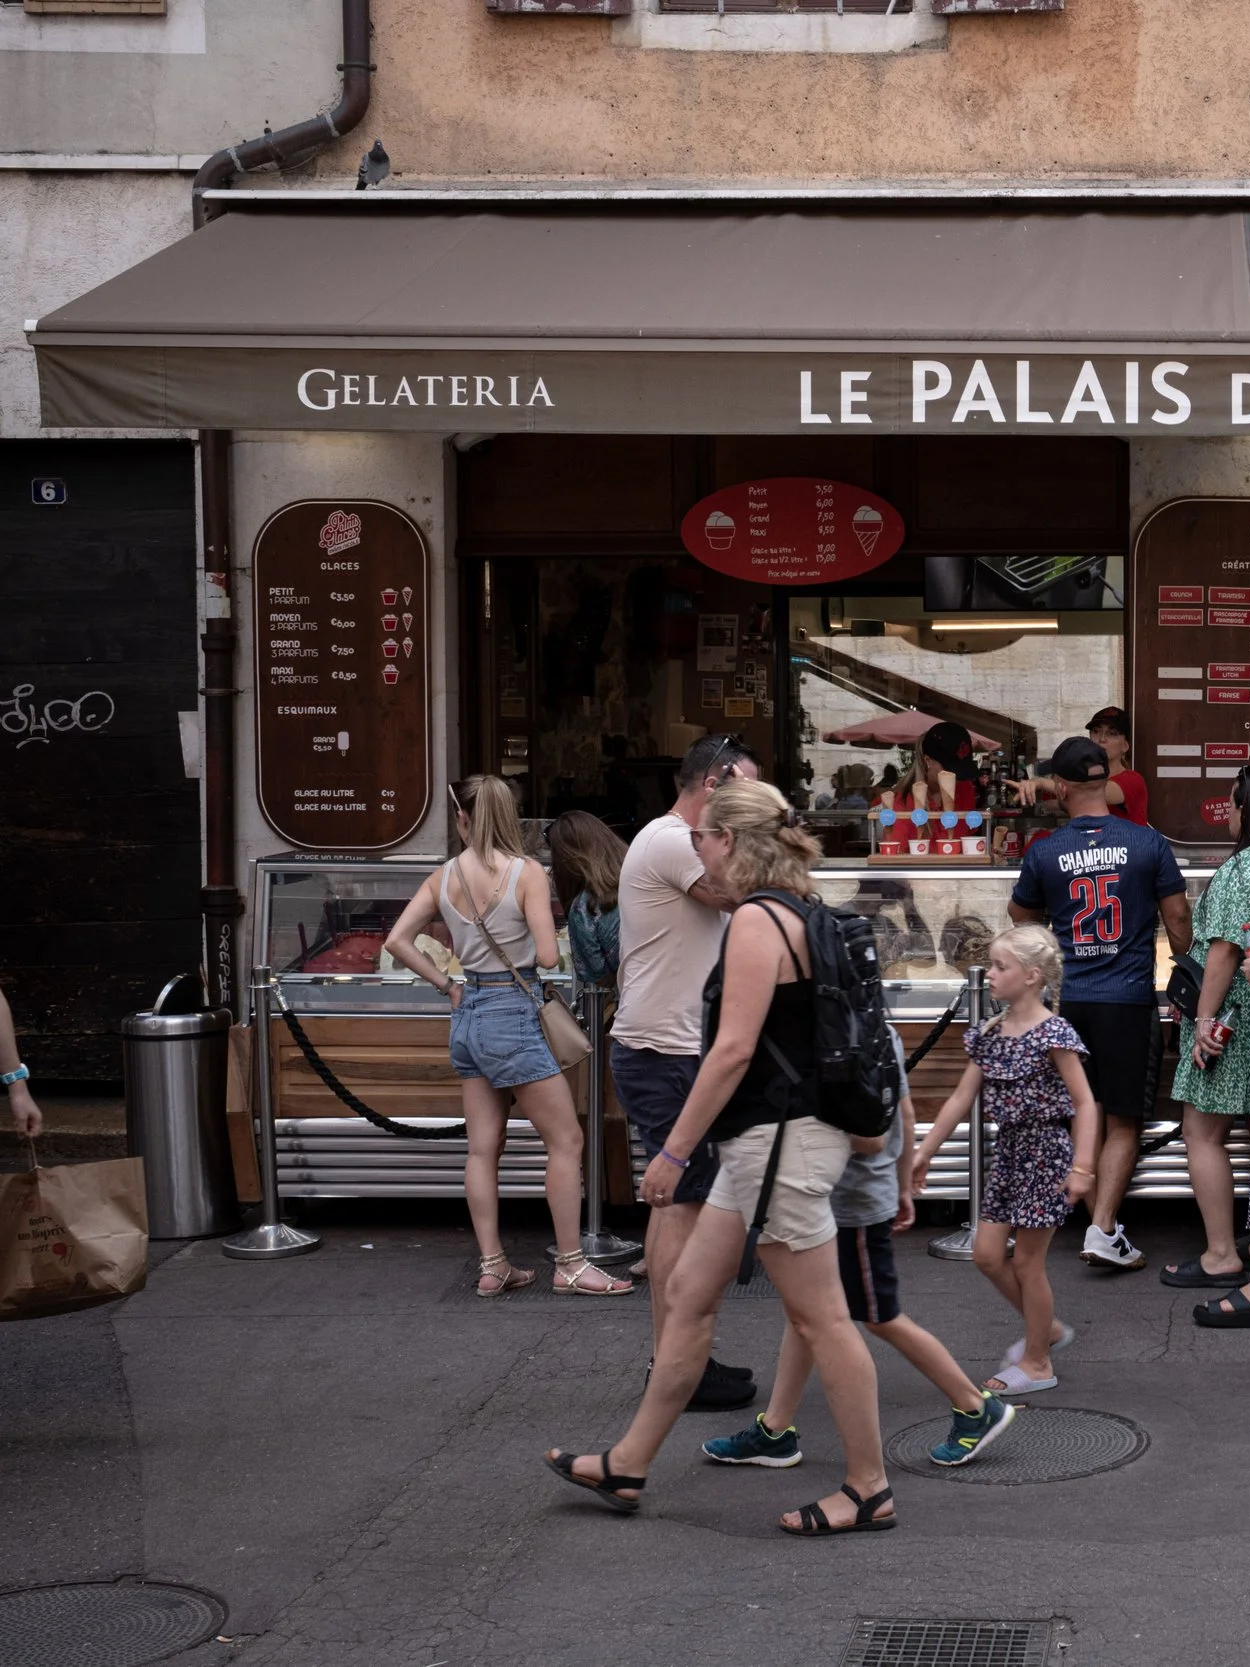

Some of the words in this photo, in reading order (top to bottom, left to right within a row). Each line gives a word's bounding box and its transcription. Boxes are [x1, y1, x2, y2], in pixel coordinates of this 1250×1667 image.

[298, 369, 555, 410] GELATERIA
[801, 372, 872, 424] LE
[913, 360, 1192, 424] PALAIS
[41, 481, 56, 501] 6
[749, 486, 767, 496] Petit
[815, 485, 833, 495] 3,50
[749, 501, 768, 511] Moyen
[816, 498, 833, 509] 6,00
[750, 513, 770, 523] Grand
[817, 512, 834, 522] 7,50
[321, 562, 360, 570] GLACES
[269, 588, 294, 596] PETIT
[330, 592, 354, 601] €3,50
[270, 614, 301, 622] MOYEN
[331, 618, 356, 629] €6,00
[277, 623, 318, 631] PARFUMS
[271, 640, 300, 648] GRAND
[331, 645, 354, 656] €7,50
[271, 650, 277, 658] 3
[278, 649, 318, 657] PARFUMS
[271, 667, 293, 675] MAXI
[332, 671, 357, 680] €8,50
[271, 677, 276, 685] 4
[278, 676, 318, 684] PARFUMS
[278, 706, 337, 714] ESQUIMAUX
[1058, 847, 1127, 872] CHAMPIONS
[1073, 867, 1084, 875] OF
[1085, 864, 1115, 873] EUROPE
[1069, 873, 1123, 945] 25
[1074, 946, 1082, 956] ICI
[1101, 944, 1119, 954] PARIS
